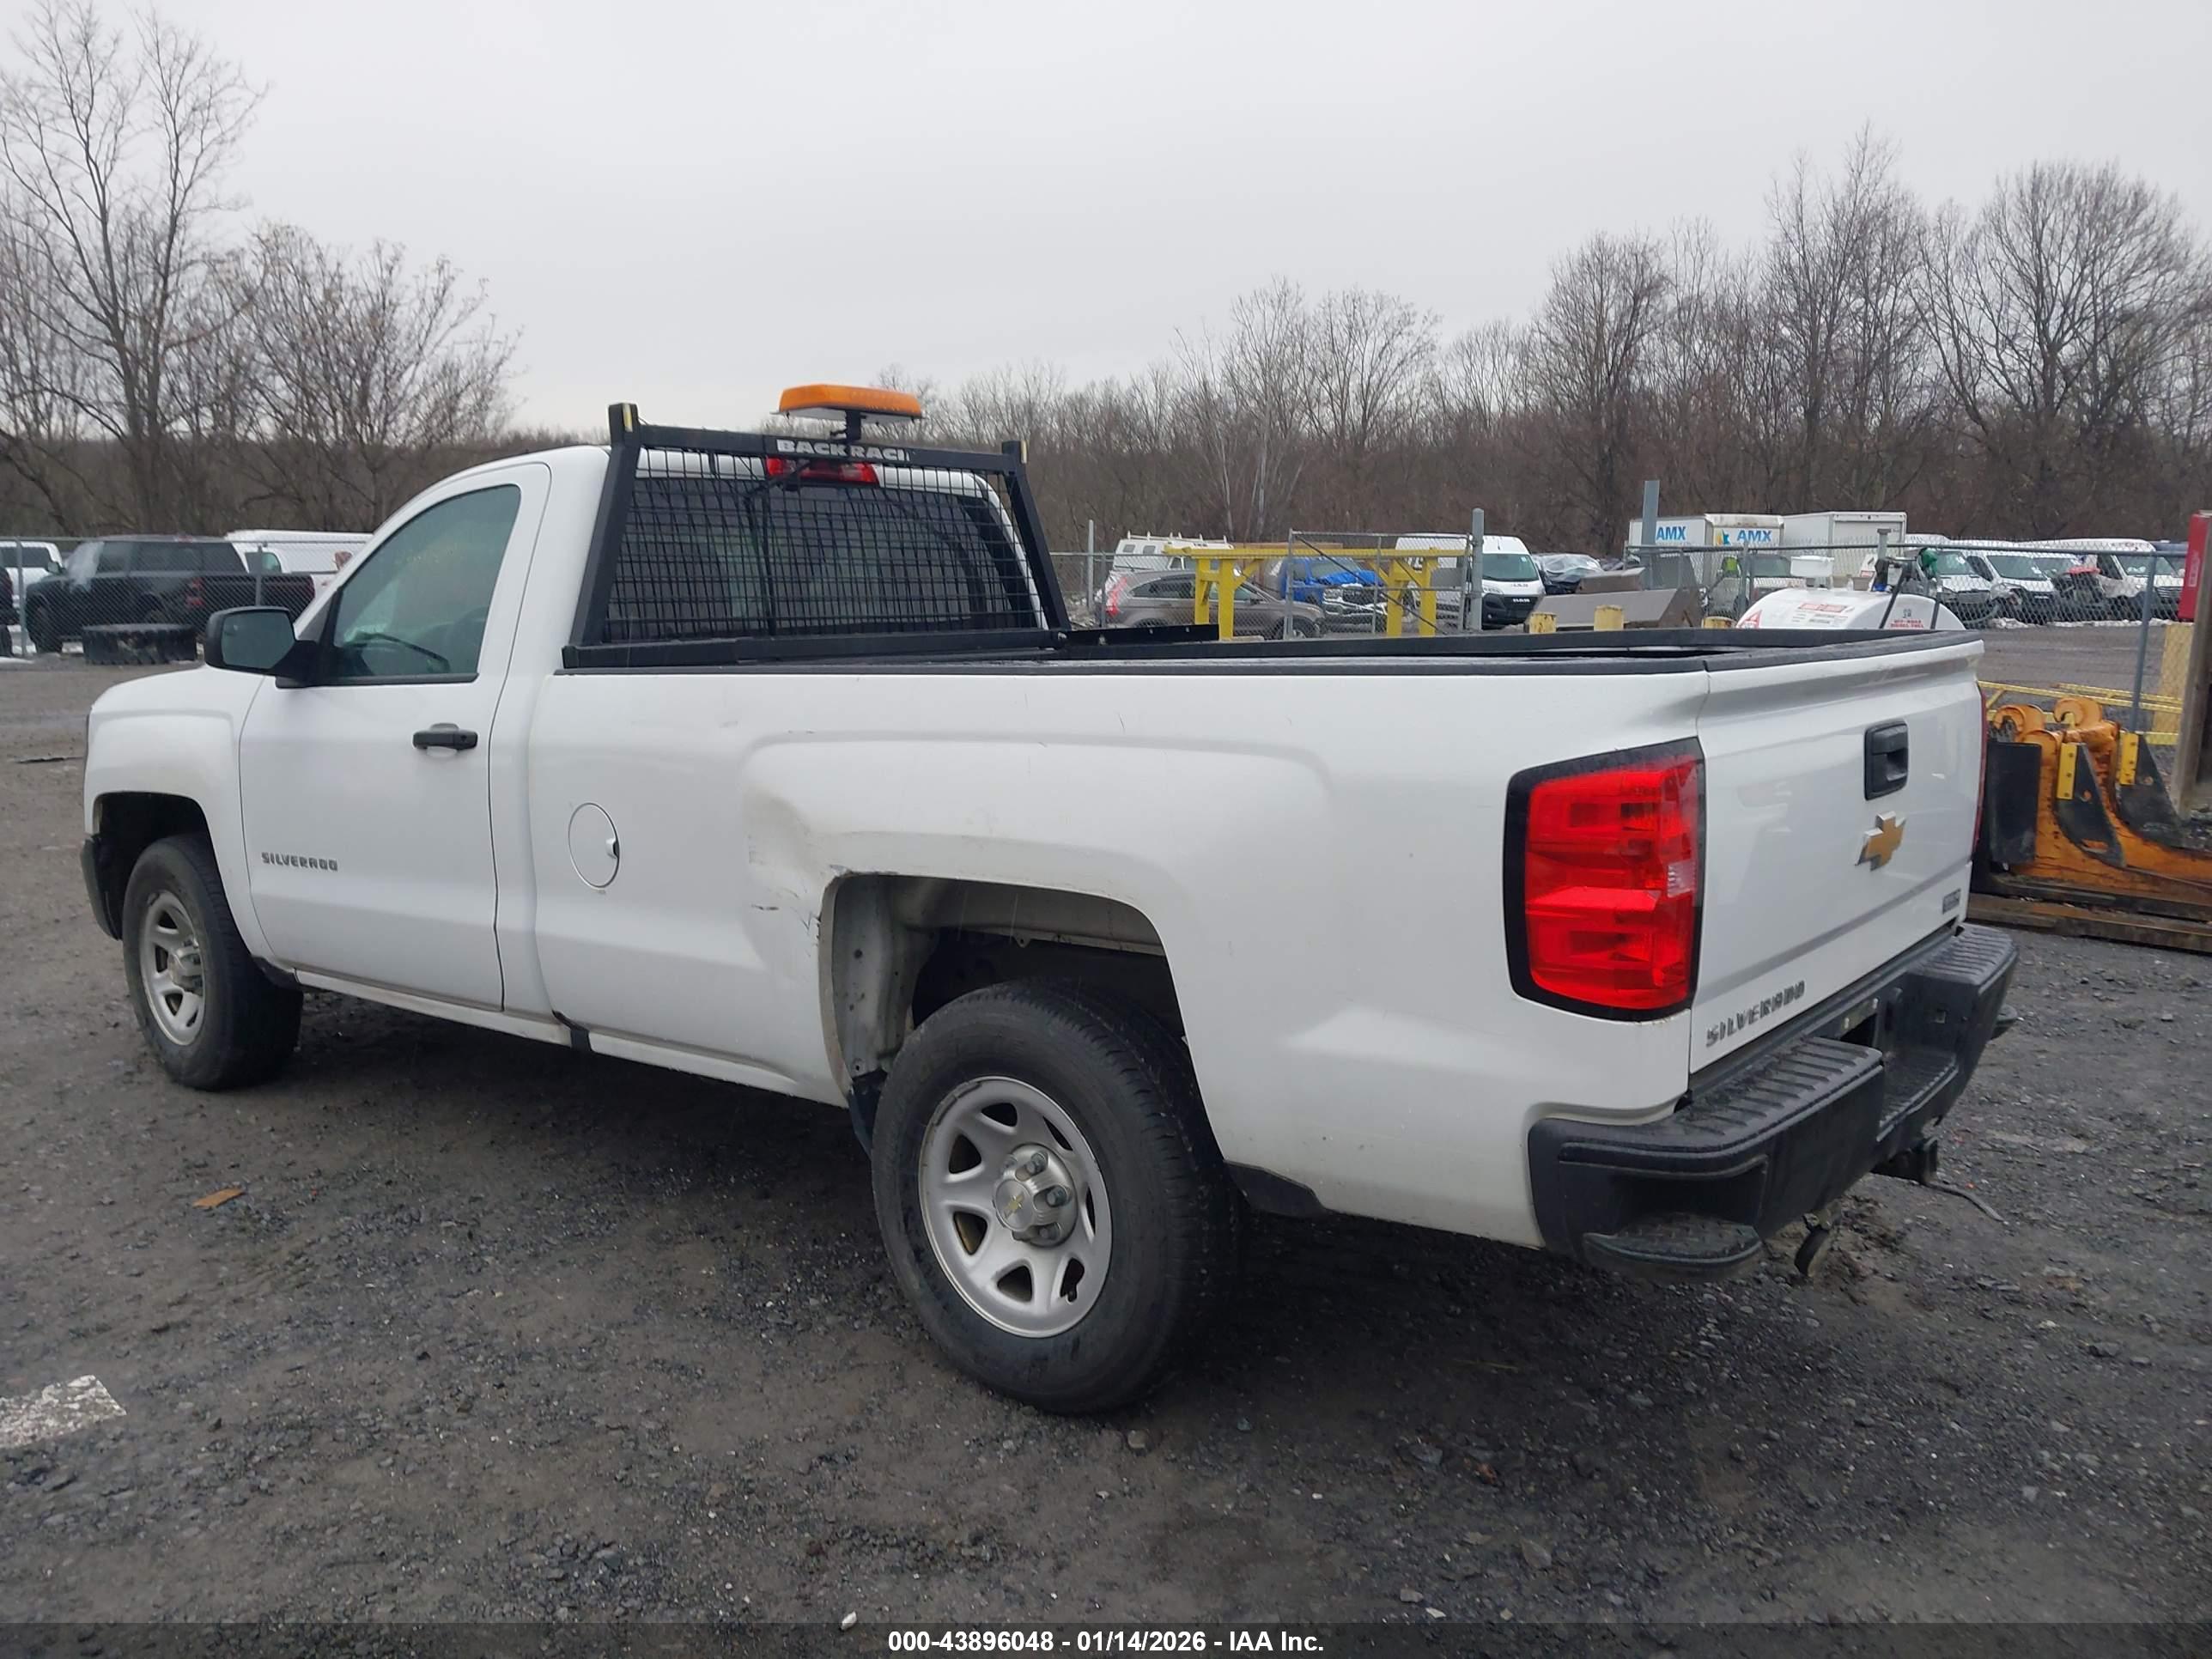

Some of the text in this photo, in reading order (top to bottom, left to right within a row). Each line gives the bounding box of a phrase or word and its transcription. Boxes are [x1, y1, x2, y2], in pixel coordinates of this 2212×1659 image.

[1656, 526, 1686, 540] AMX
[1737, 530, 1771, 542] AMX
[261, 852, 338, 872] SILVERADO
[1706, 980, 1805, 1048] SILVERADO
